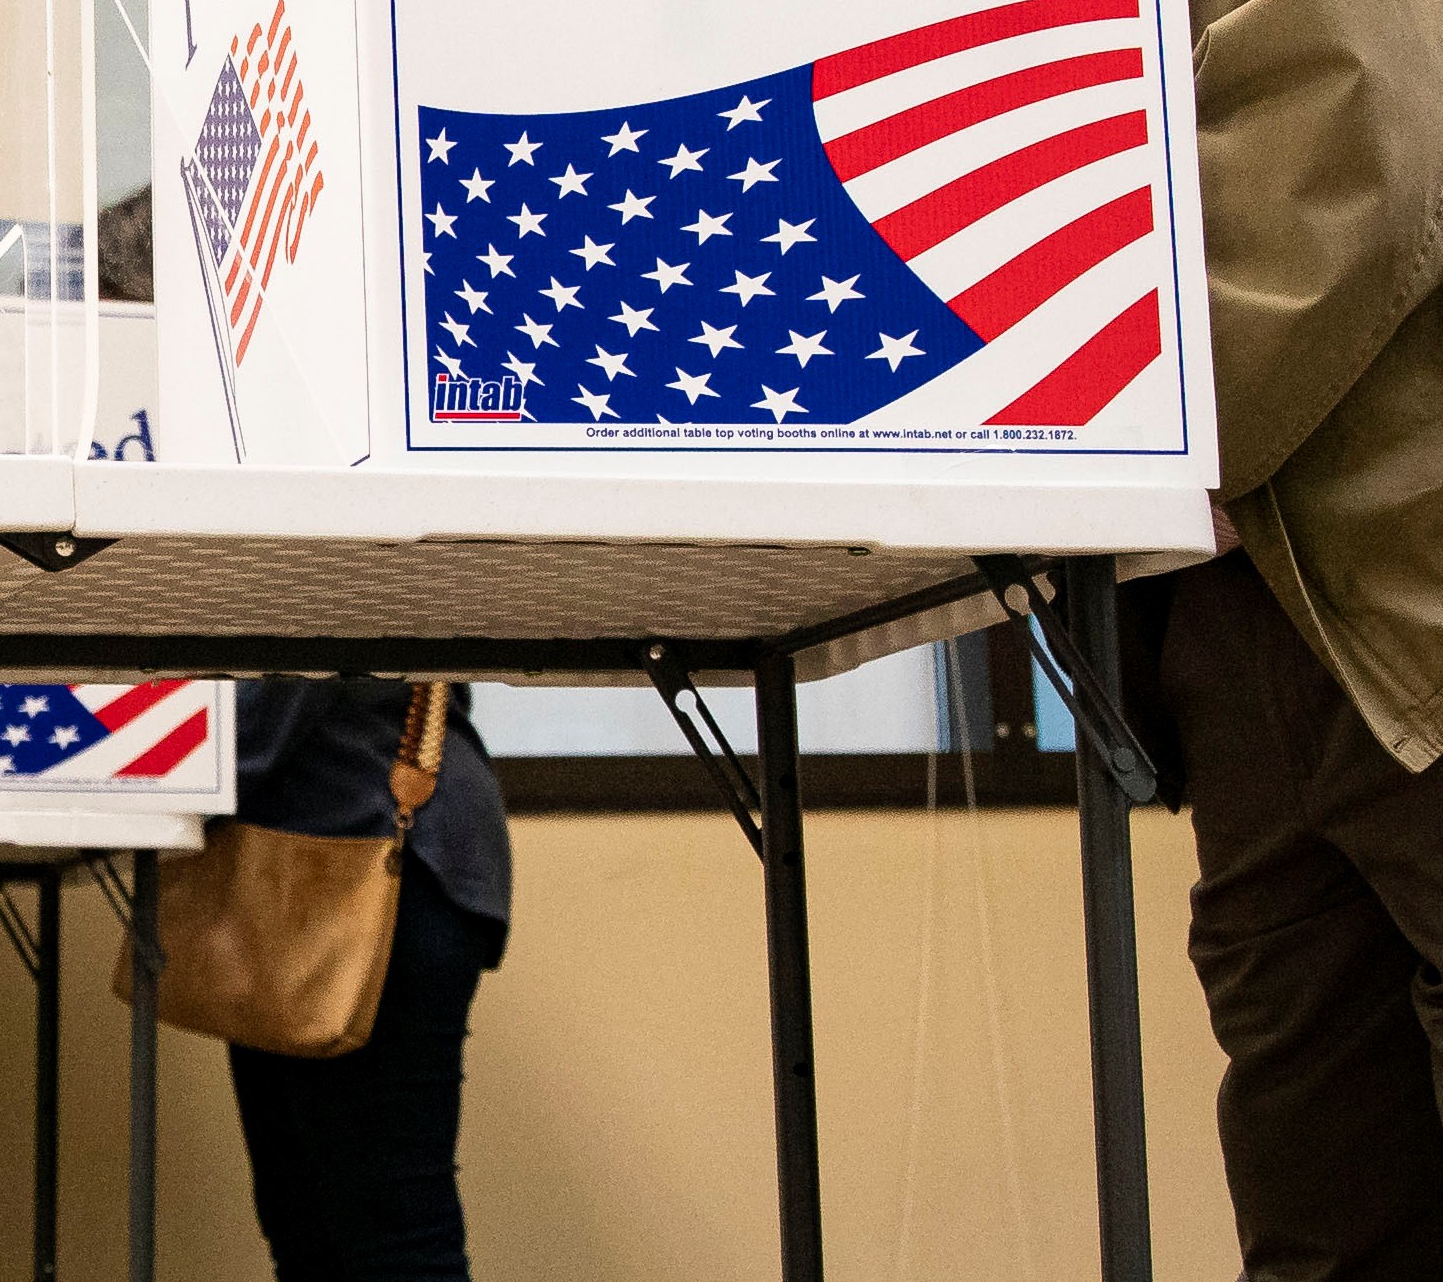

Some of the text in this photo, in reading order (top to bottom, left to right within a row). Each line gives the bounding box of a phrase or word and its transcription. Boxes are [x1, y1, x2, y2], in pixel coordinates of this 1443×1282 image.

[434, 373, 525, 412] intab
[586, 427, 1078, 440] Order additional table top voting booths online at www.intab.net or call 1.800.232.1872.
